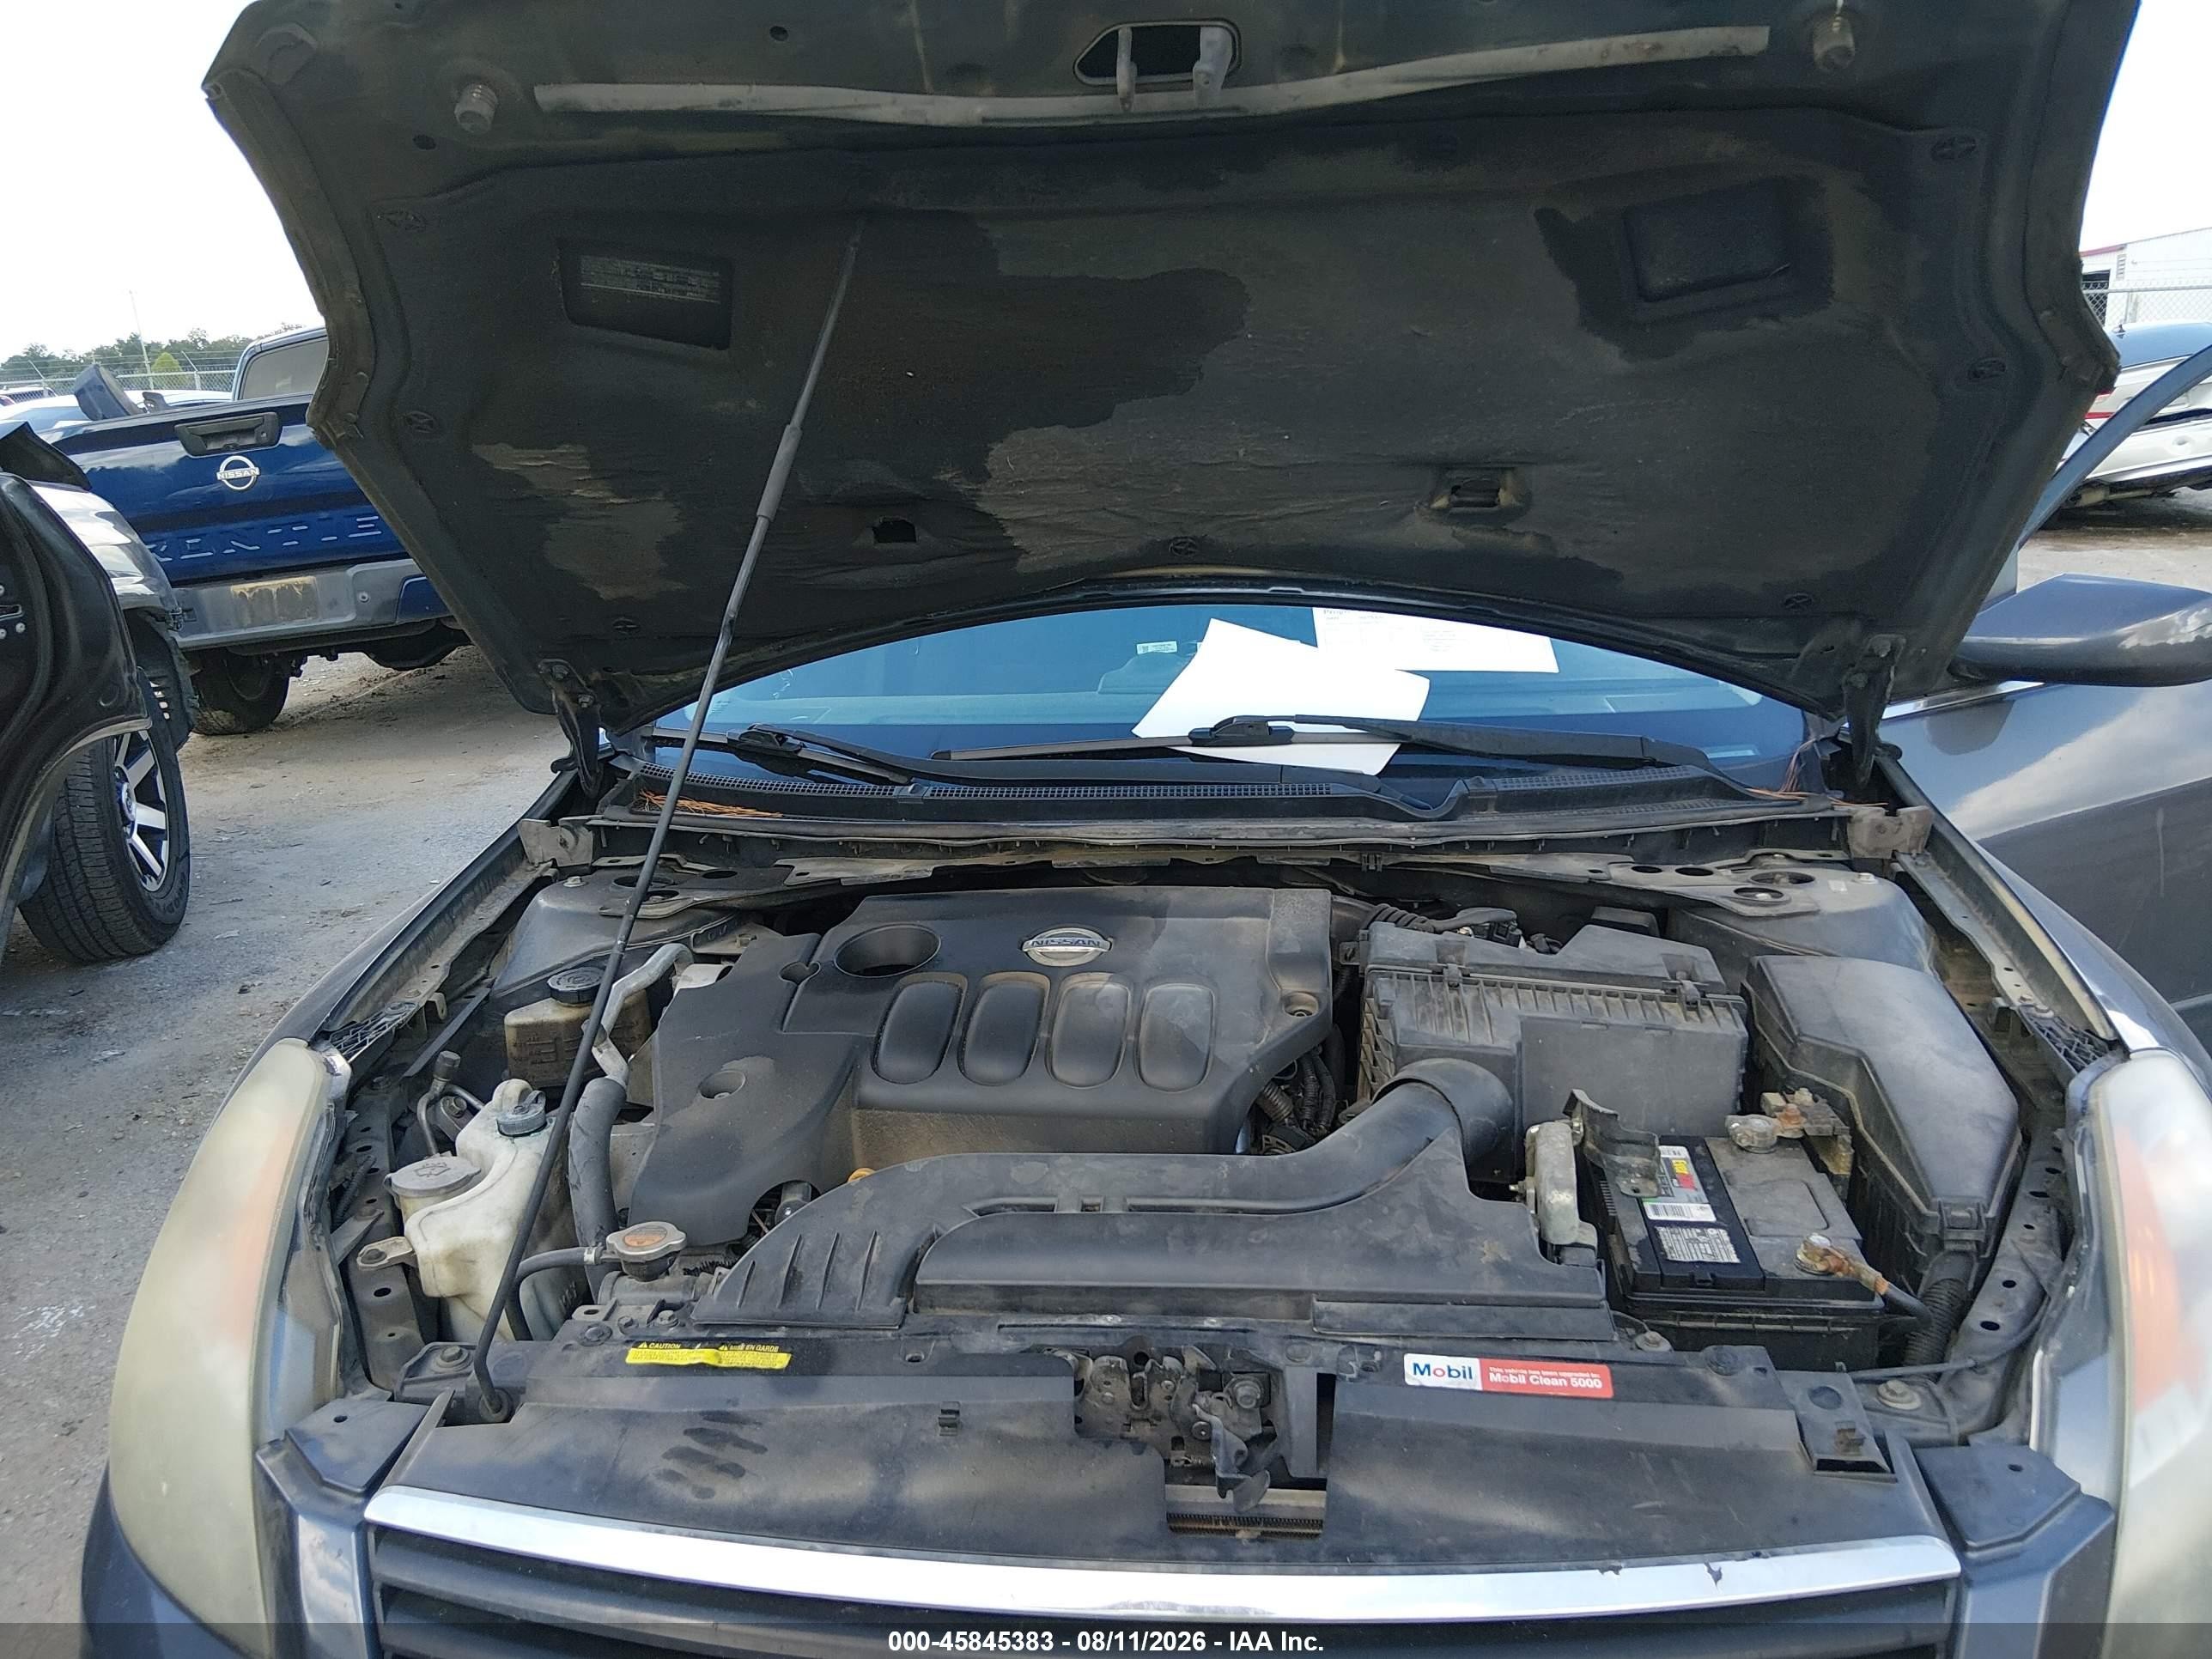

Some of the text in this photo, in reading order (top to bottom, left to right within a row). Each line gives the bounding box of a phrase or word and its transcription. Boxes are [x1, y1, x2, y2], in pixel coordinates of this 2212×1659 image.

[218, 468, 259, 479] NISSAN
[1412, 1362, 1474, 1380] Mobil
[1489, 1372, 1603, 1389] Mobil Clean 5000
